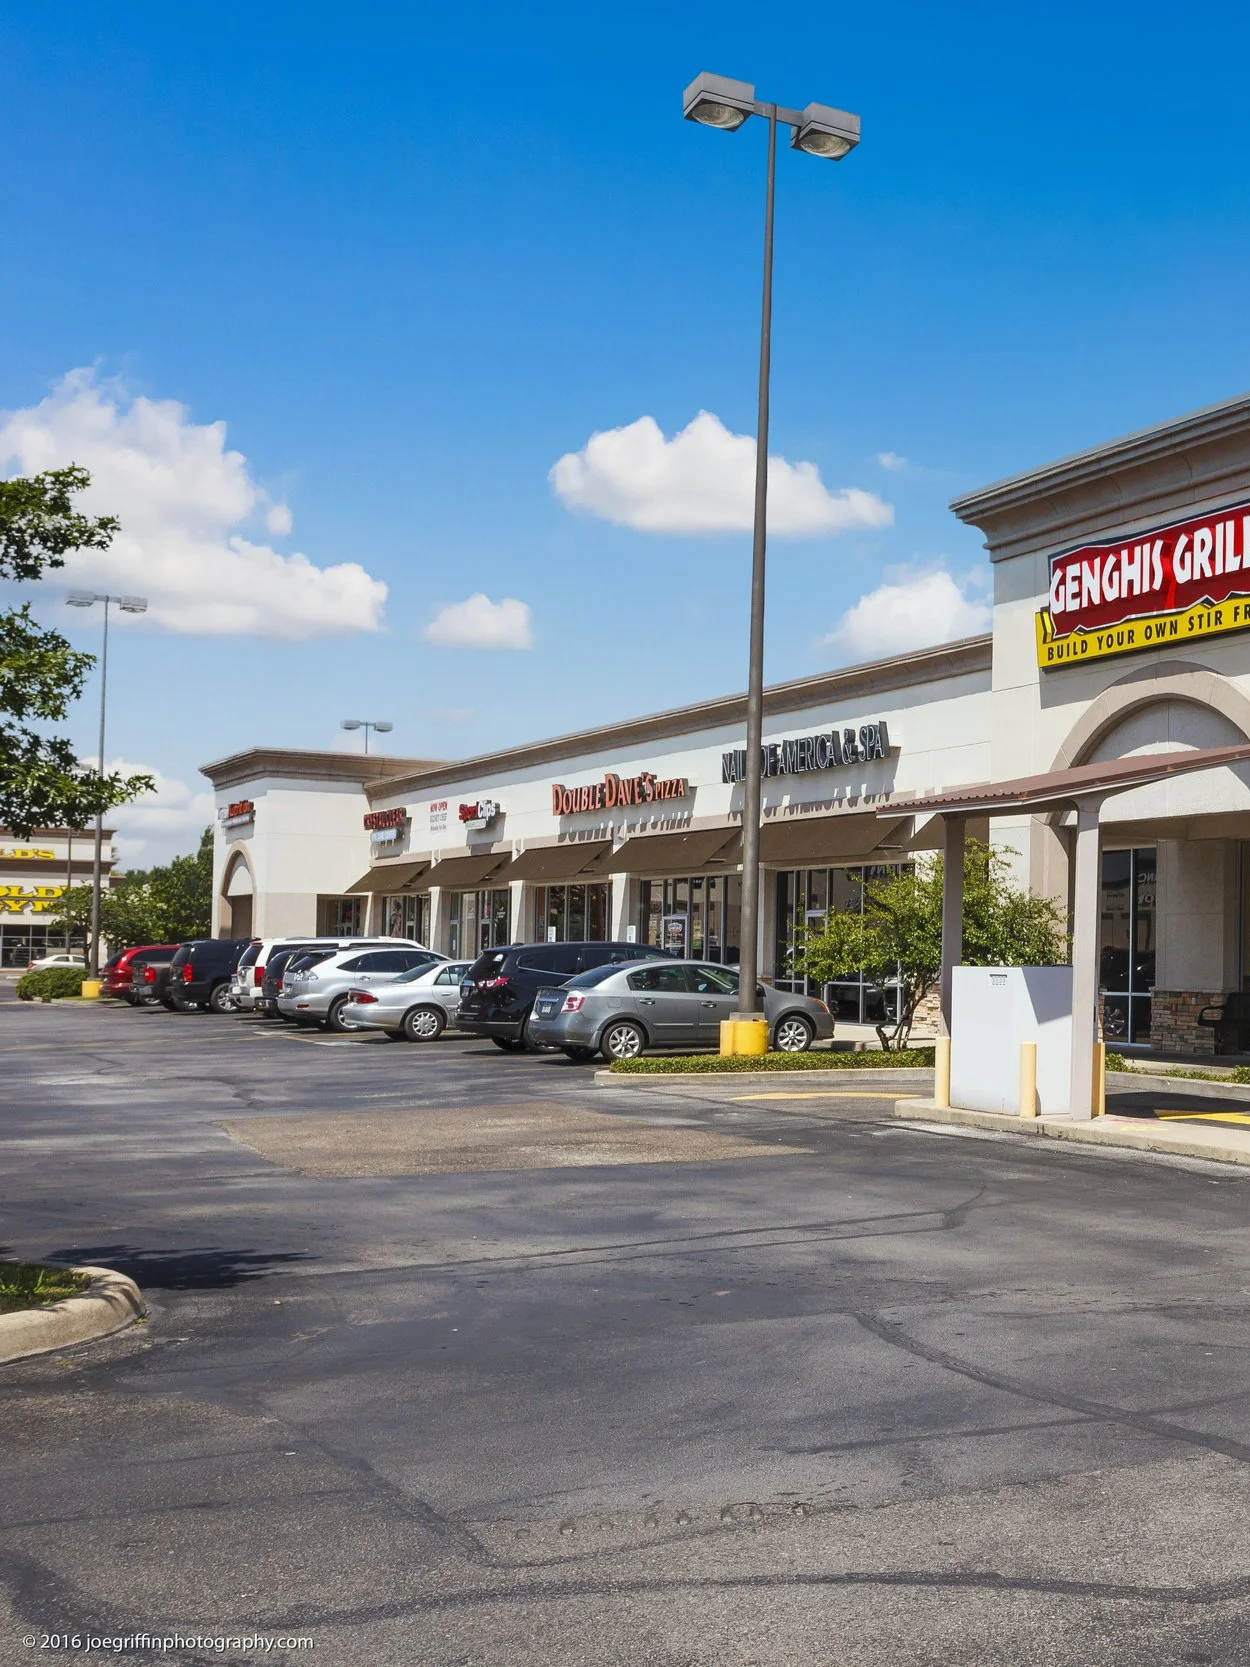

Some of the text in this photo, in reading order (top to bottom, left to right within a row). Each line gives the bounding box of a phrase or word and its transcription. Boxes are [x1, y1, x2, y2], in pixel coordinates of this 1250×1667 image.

[1050, 539, 1165, 615] GENGHIS
[1047, 640, 1088, 661] BUILD
[1096, 629, 1136, 650] YOUR
[1144, 619, 1179, 640] OWN
[1188, 610, 1223, 632] STIR
[722, 749, 749, 784] NAIL
[778, 731, 840, 775] AMERICA
[842, 728, 858, 765] &
[859, 721, 889, 761] SPA
[552, 772, 688, 816] DOUBLE DAVE'S PIZZA
